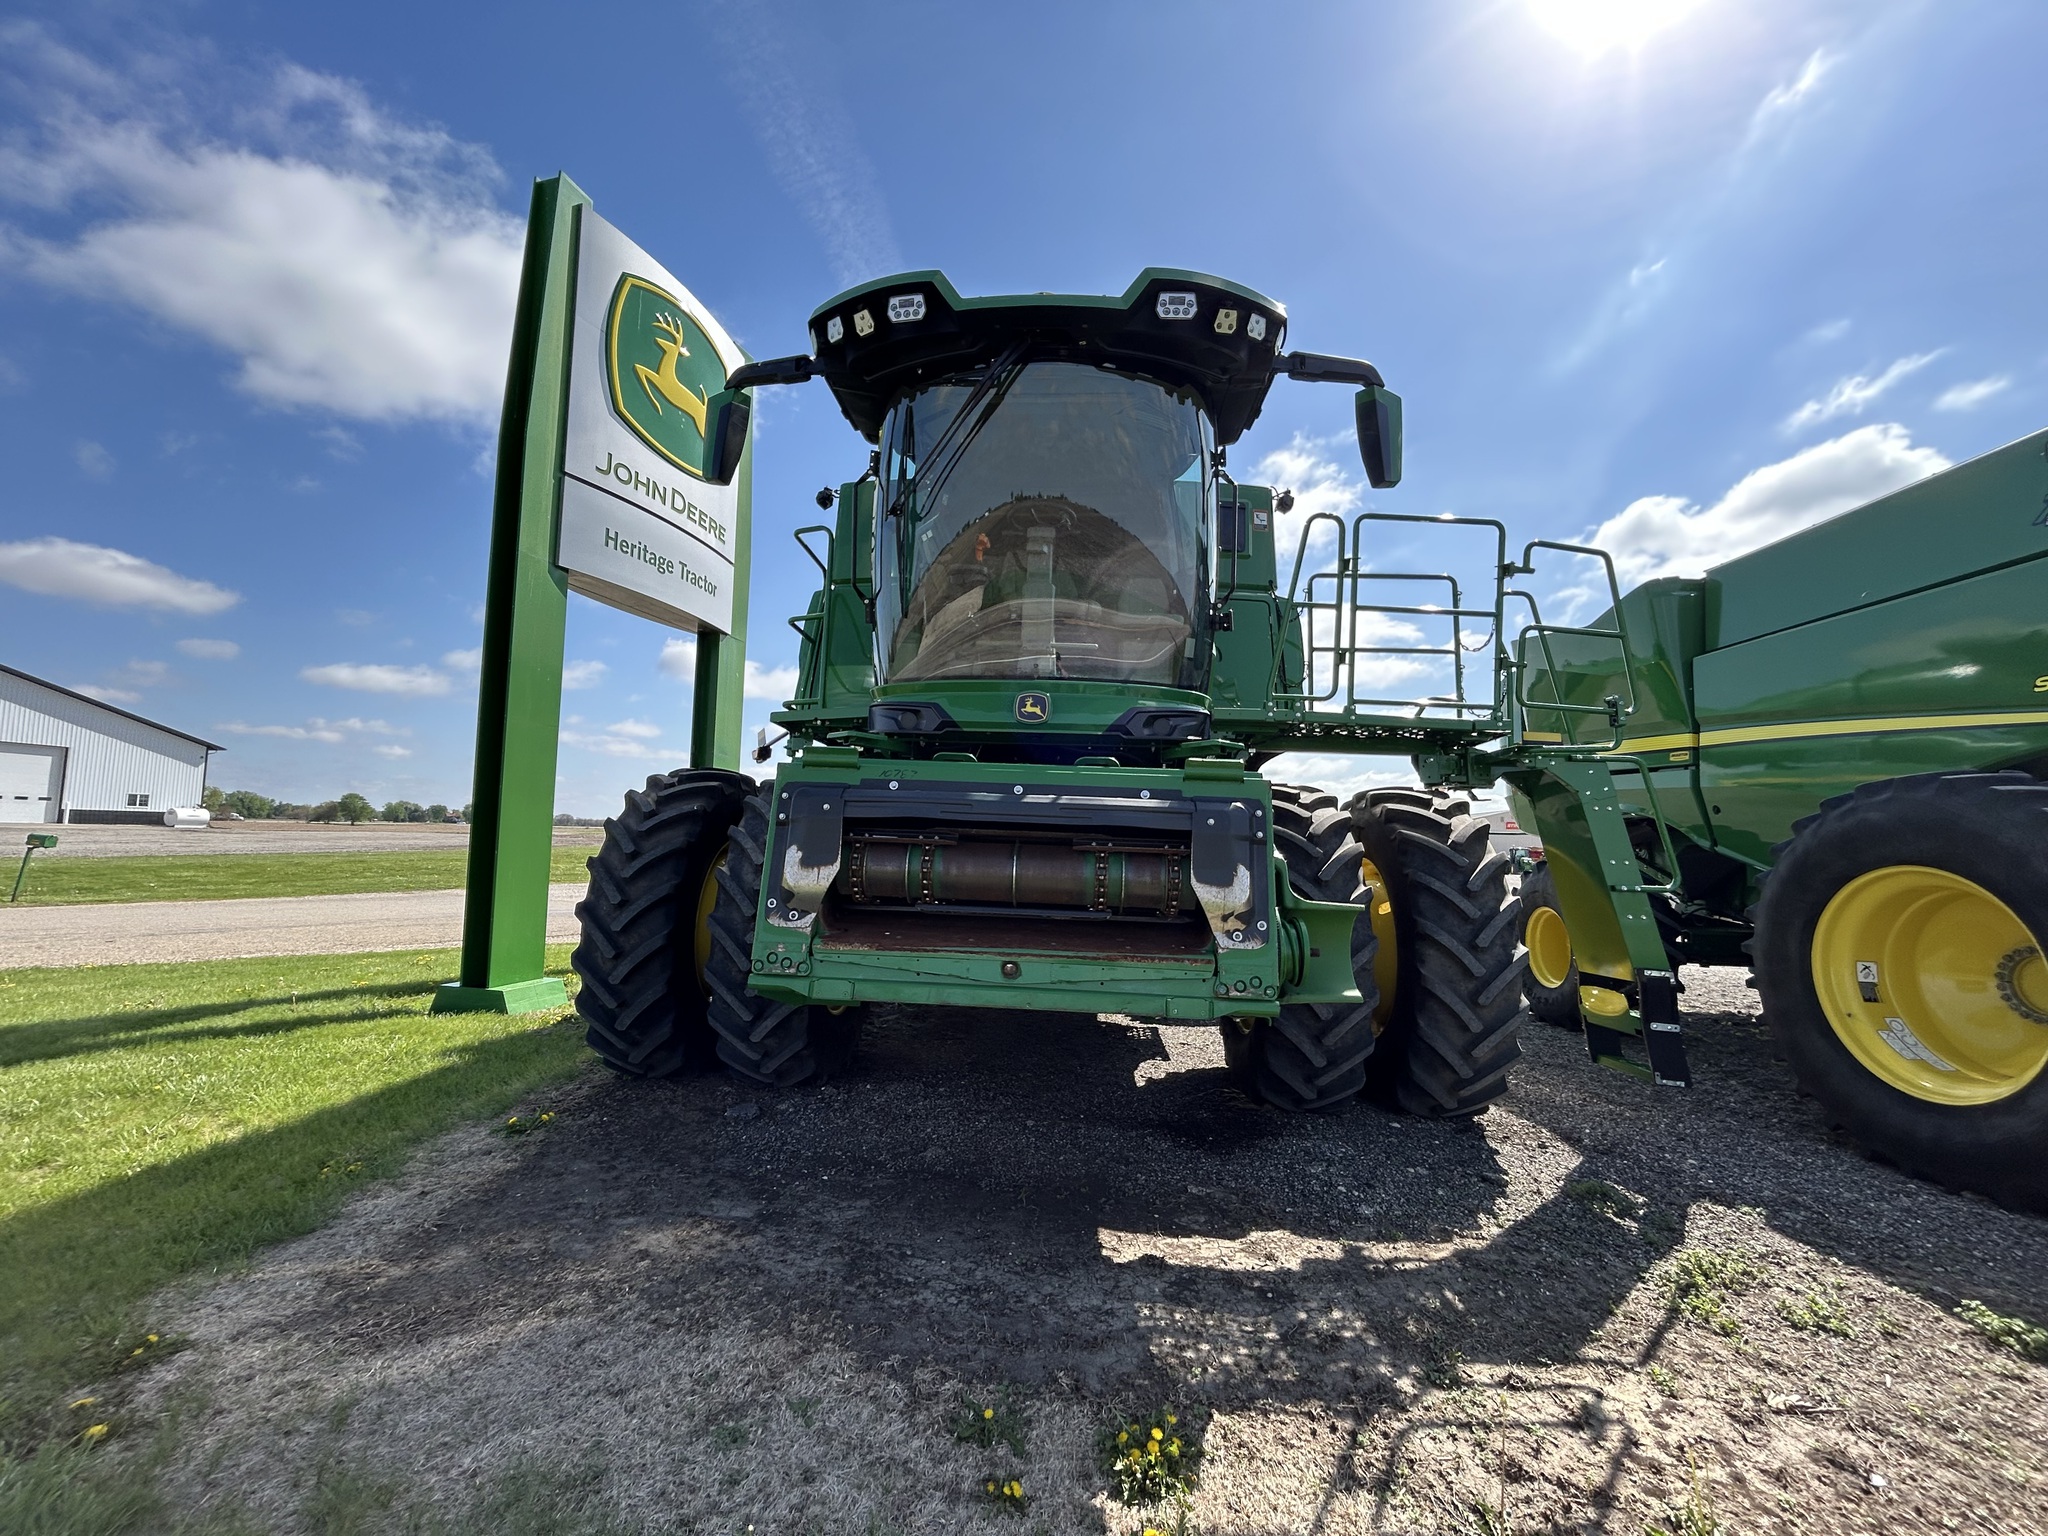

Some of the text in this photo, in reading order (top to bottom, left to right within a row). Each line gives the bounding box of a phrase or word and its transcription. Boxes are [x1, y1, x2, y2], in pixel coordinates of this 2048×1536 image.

[595, 452, 727, 546] JOHN DEERE
[604, 527, 718, 598] Heritage Tractor
